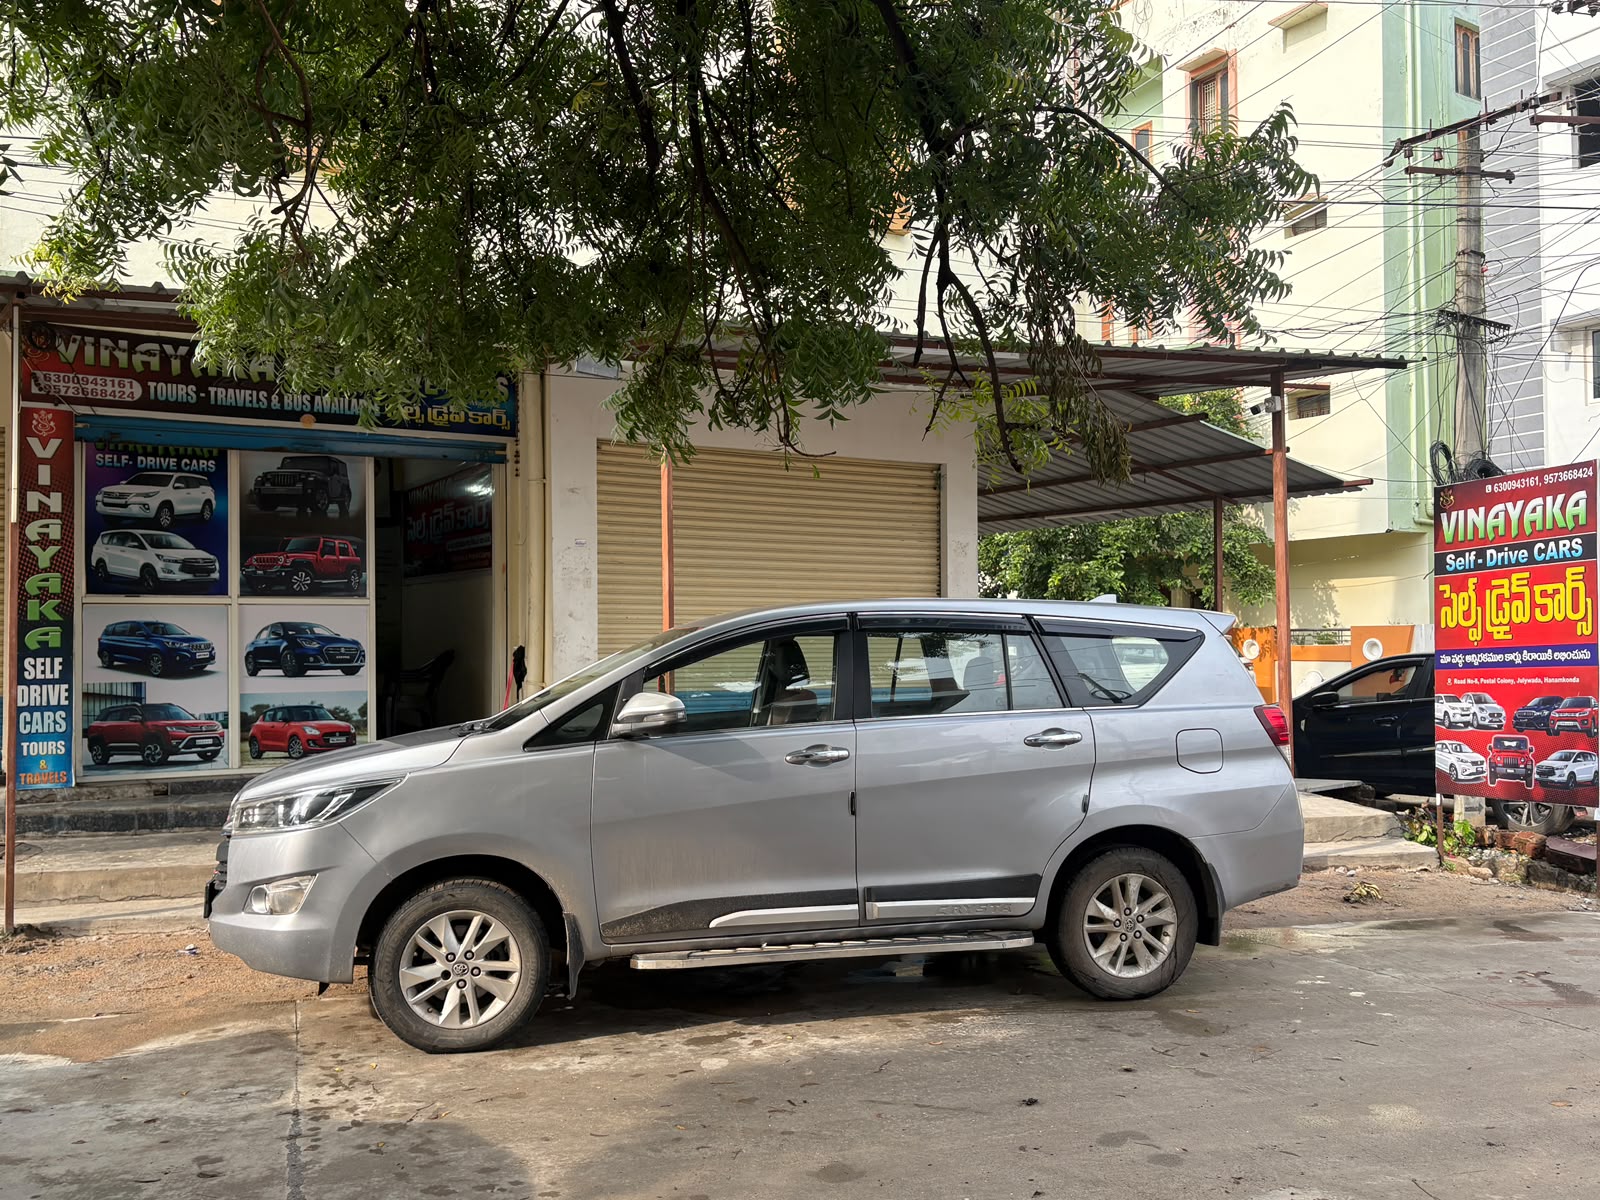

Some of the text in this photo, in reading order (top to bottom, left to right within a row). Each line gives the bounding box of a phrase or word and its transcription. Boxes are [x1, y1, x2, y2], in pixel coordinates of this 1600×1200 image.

[43, 373, 134, 389] 6300943161
[43, 384, 135, 400] 9573668424
[148, 381, 197, 404] TOURS
[208, 386, 268, 410] TRAVELS
[271, 394, 280, 411] &
[284, 394, 312, 412] BUS
[313, 395, 381, 417] AVAILA
[137, 455, 178, 471] DRIVE
[181, 458, 217, 473] CARS
[1543, 466, 1593, 485] 9573668424
[1440, 490, 1588, 544] VINAYAKA
[24, 436, 64, 651] VINAYAKA
[1486, 546, 1529, 567] Drive
[1533, 538, 1584, 562] CARS
[1438, 566, 1593, 646] సెల్ఫ్ డ్రైవ్ కార్స్
[23, 657, 63, 680] SELF
[17, 684, 69, 707] DRIVE
[19, 711, 67, 734] CARS
[21, 741, 66, 756] TOURS
[39, 759, 48, 770] &
[19, 771, 67, 785] TRAVELS
